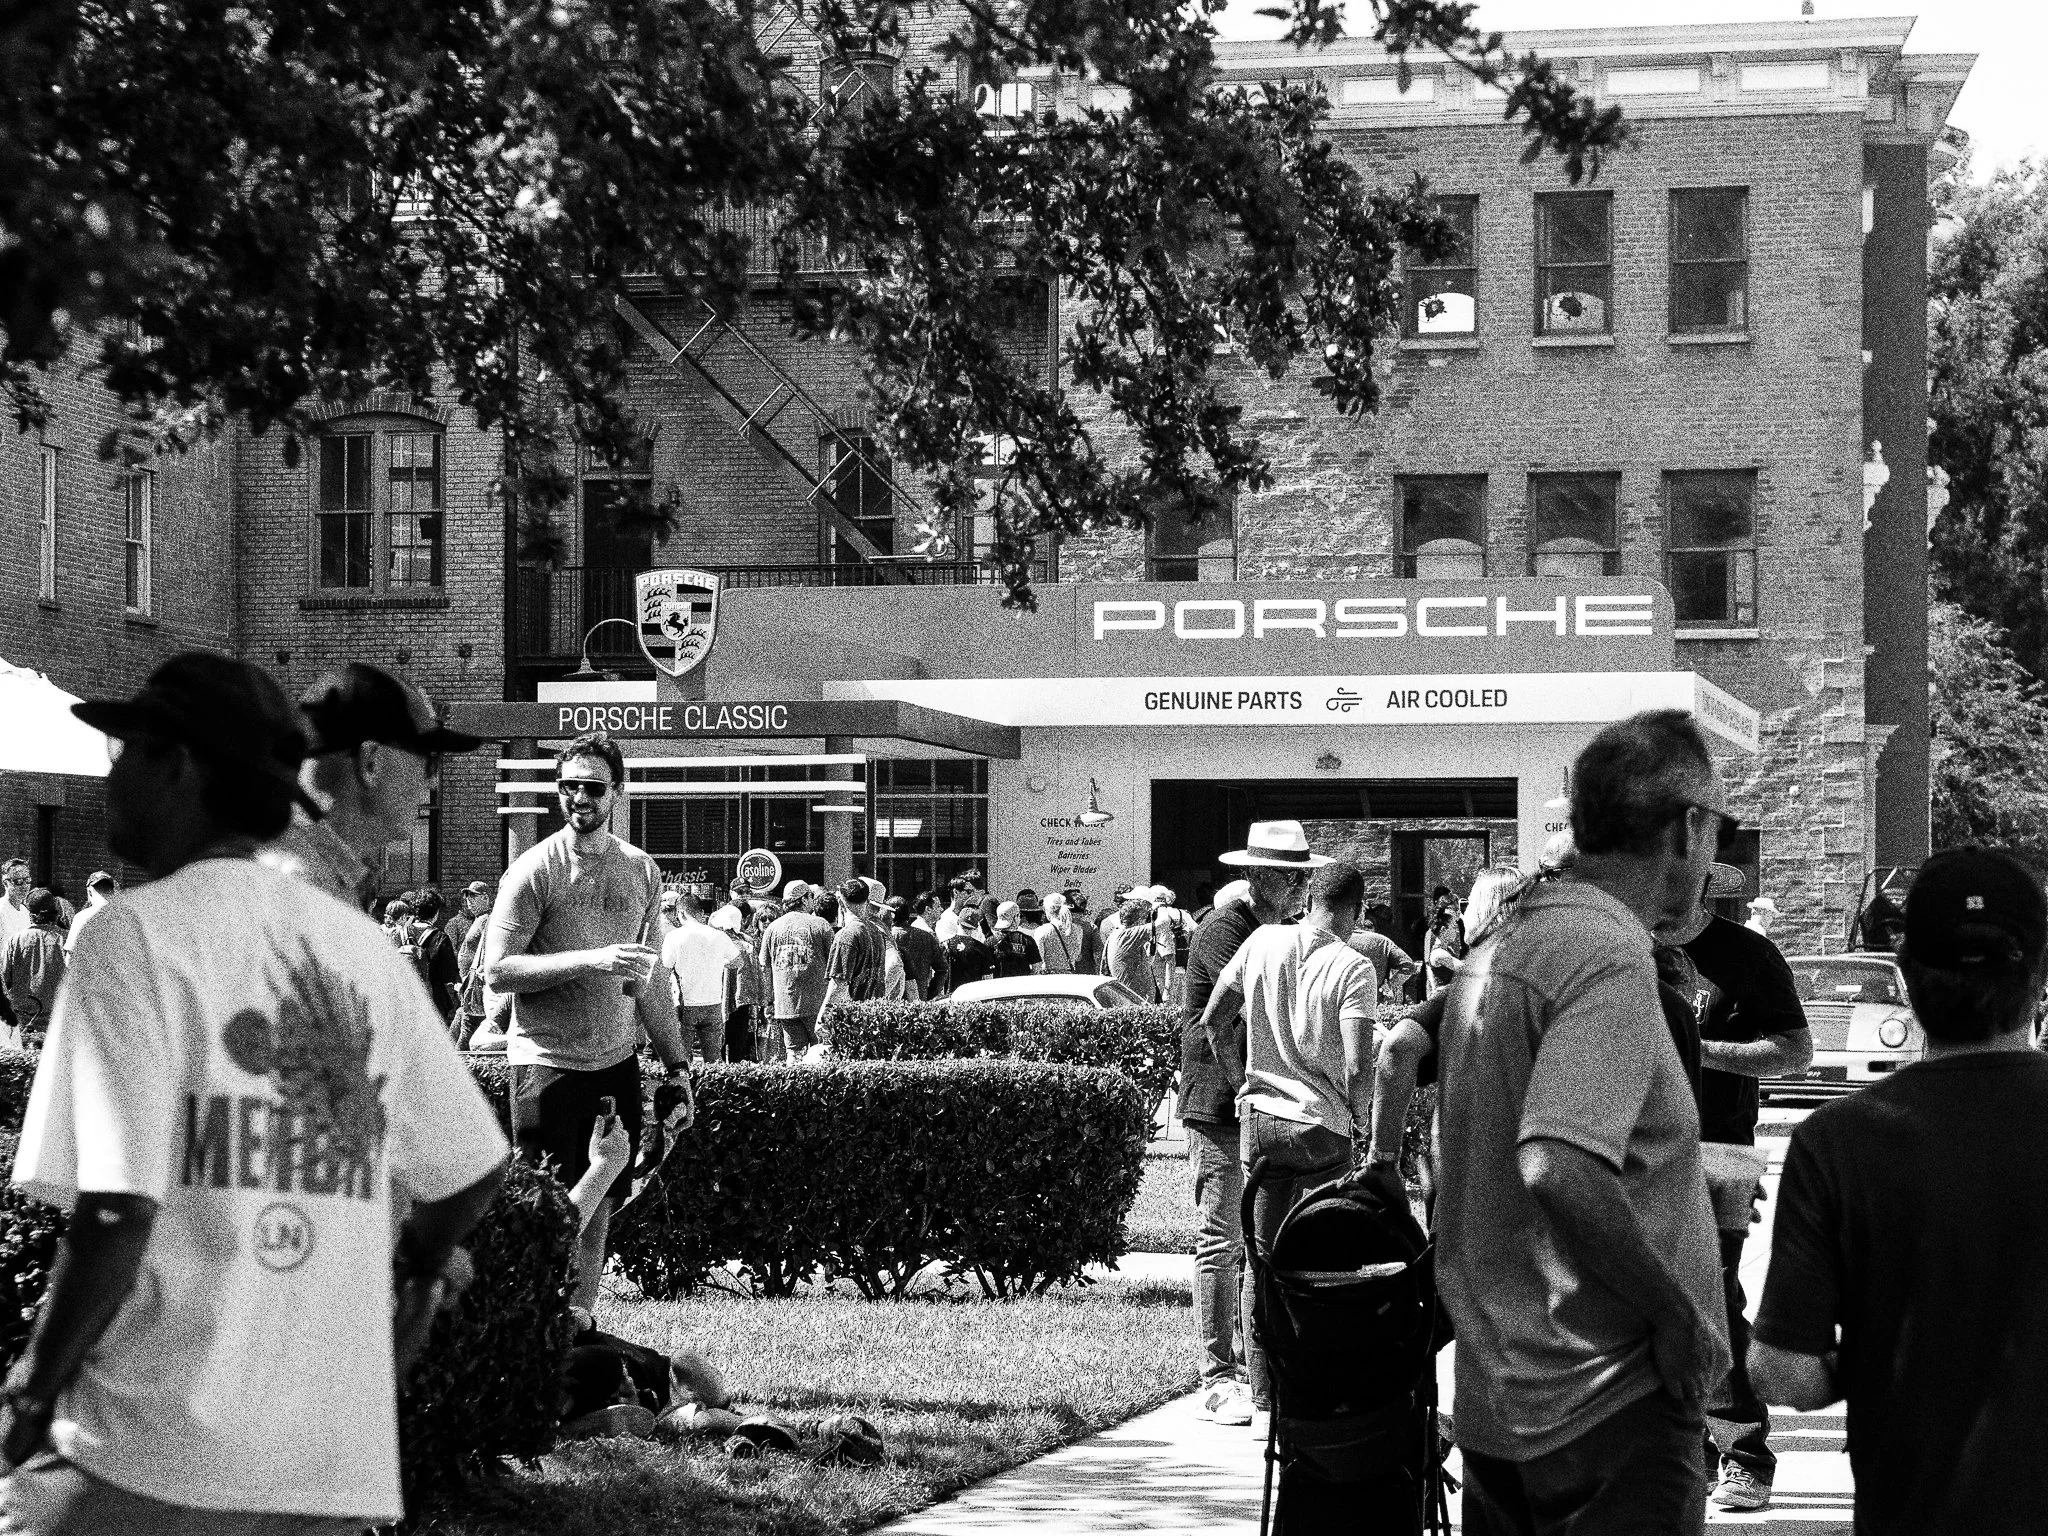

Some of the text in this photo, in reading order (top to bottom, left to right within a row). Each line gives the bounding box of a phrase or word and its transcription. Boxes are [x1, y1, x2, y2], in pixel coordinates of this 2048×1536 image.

[640, 573, 716, 590] PORSCHE
[1093, 594, 1653, 641] PORSCHE
[1144, 690, 1303, 711] GENUINE PARTS
[1386, 688, 1508, 709] AIR COOLED
[558, 704, 788, 731] PORSCHE CLASSIC
[1040, 817, 1071, 828] CHECK
[1047, 836, 1102, 846] Tires and Tubes
[1057, 850, 1090, 860] Batteries
[1050, 864, 1097, 875] Wiper Blades
[1063, 878, 1082, 888] Belts
